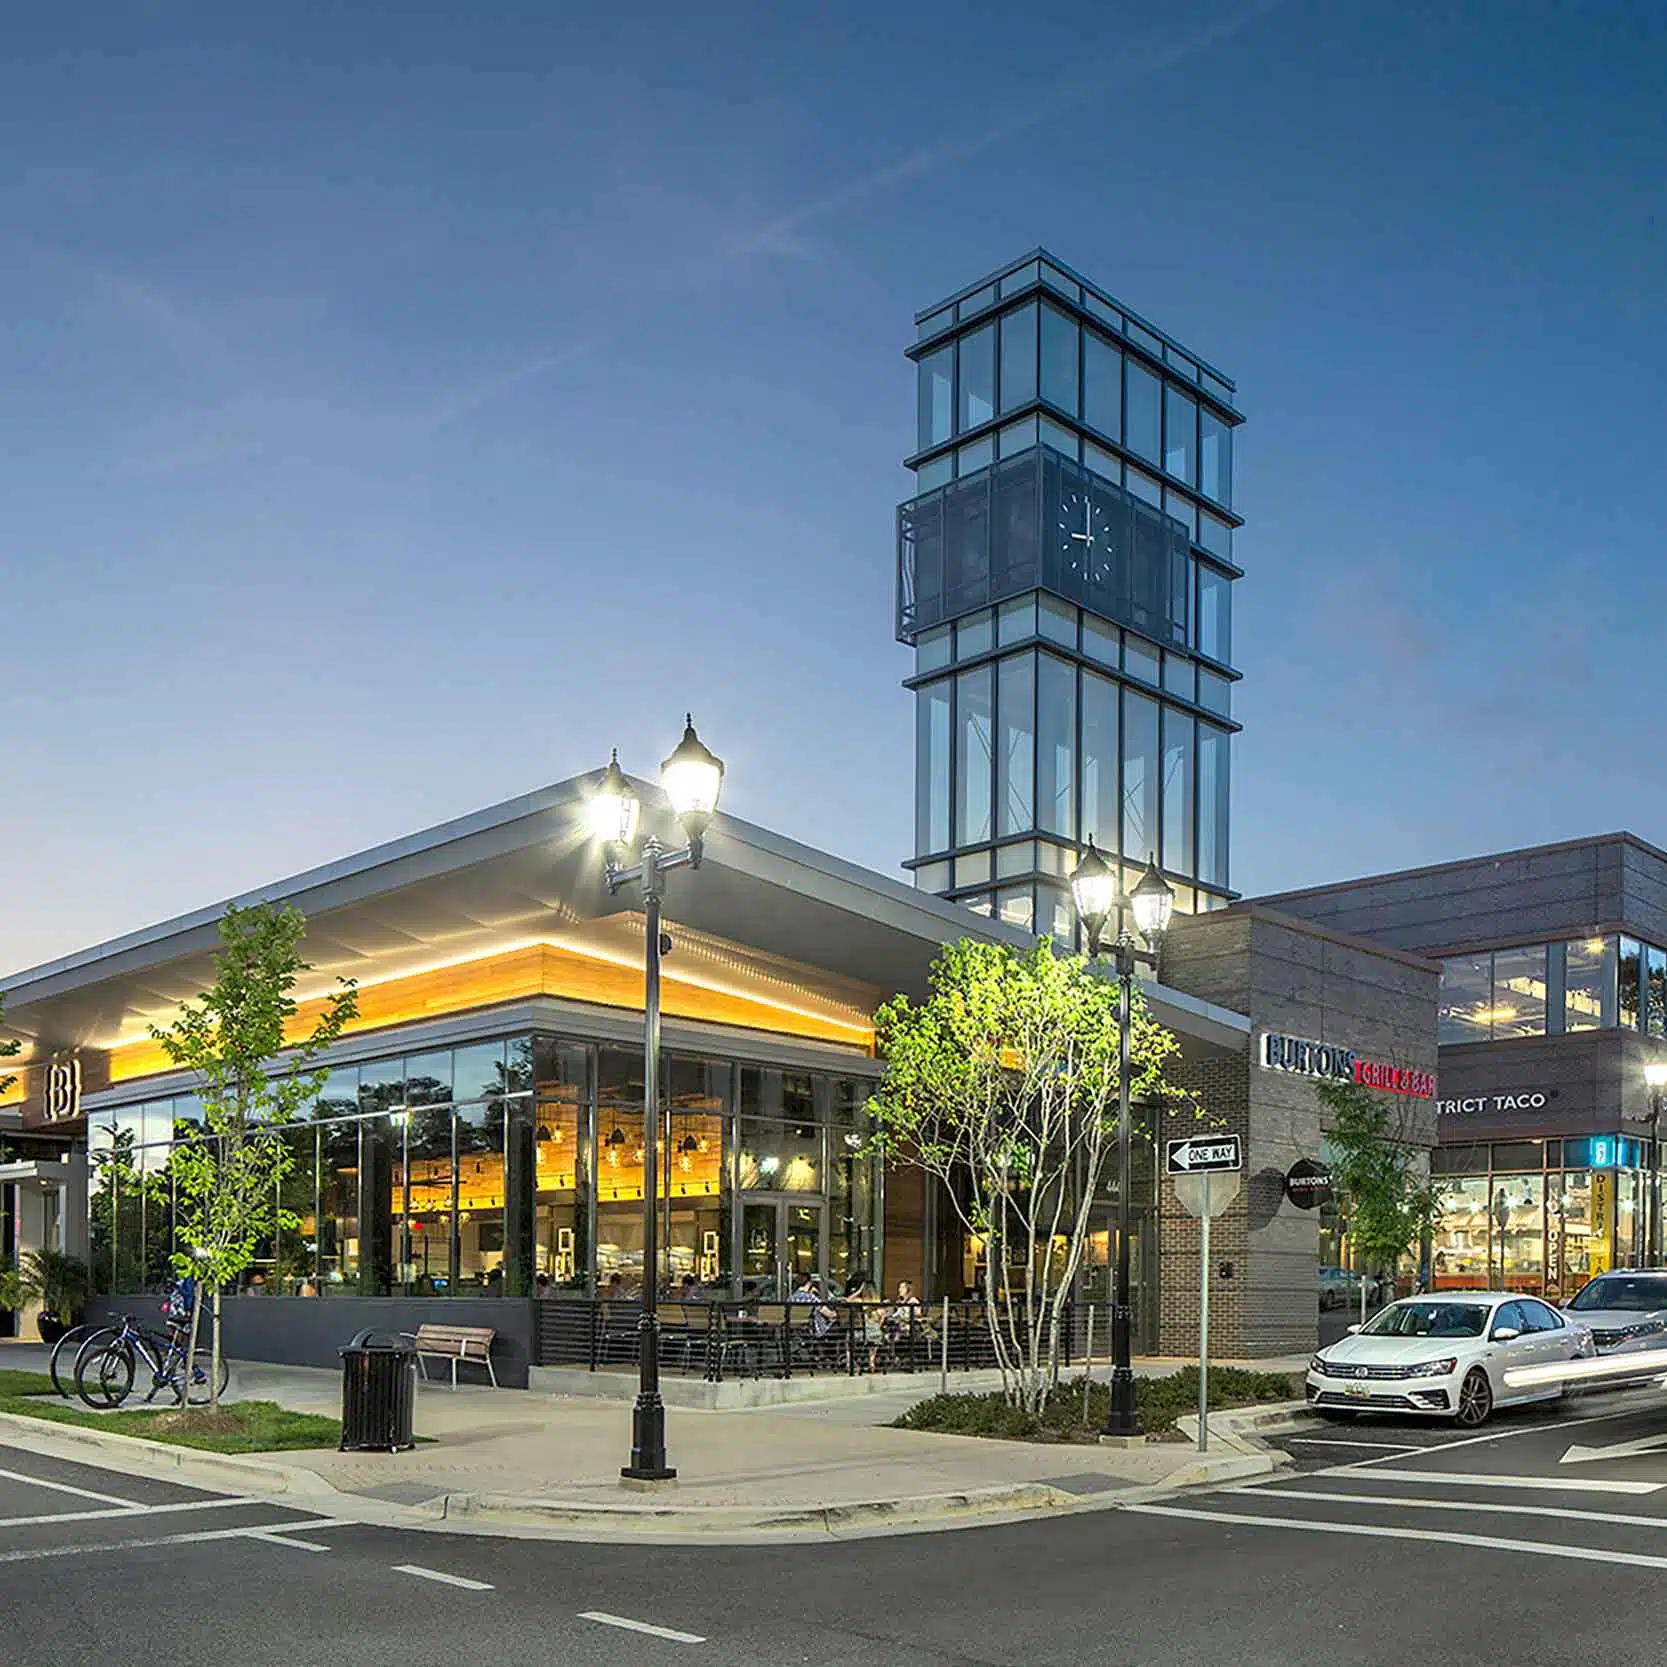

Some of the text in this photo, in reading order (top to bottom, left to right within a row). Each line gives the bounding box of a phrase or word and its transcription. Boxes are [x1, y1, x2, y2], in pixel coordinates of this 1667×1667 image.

[1264, 1033, 1357, 1081] BURTONS
[1360, 1061, 1399, 1089] GRILL
[1493, 1093, 1545, 1110] TACO
[1189, 1146, 1233, 1161] ONE WAY
[1596, 1174, 1606, 1241] DISTRI
[1547, 1231, 1558, 1280] OPEN
